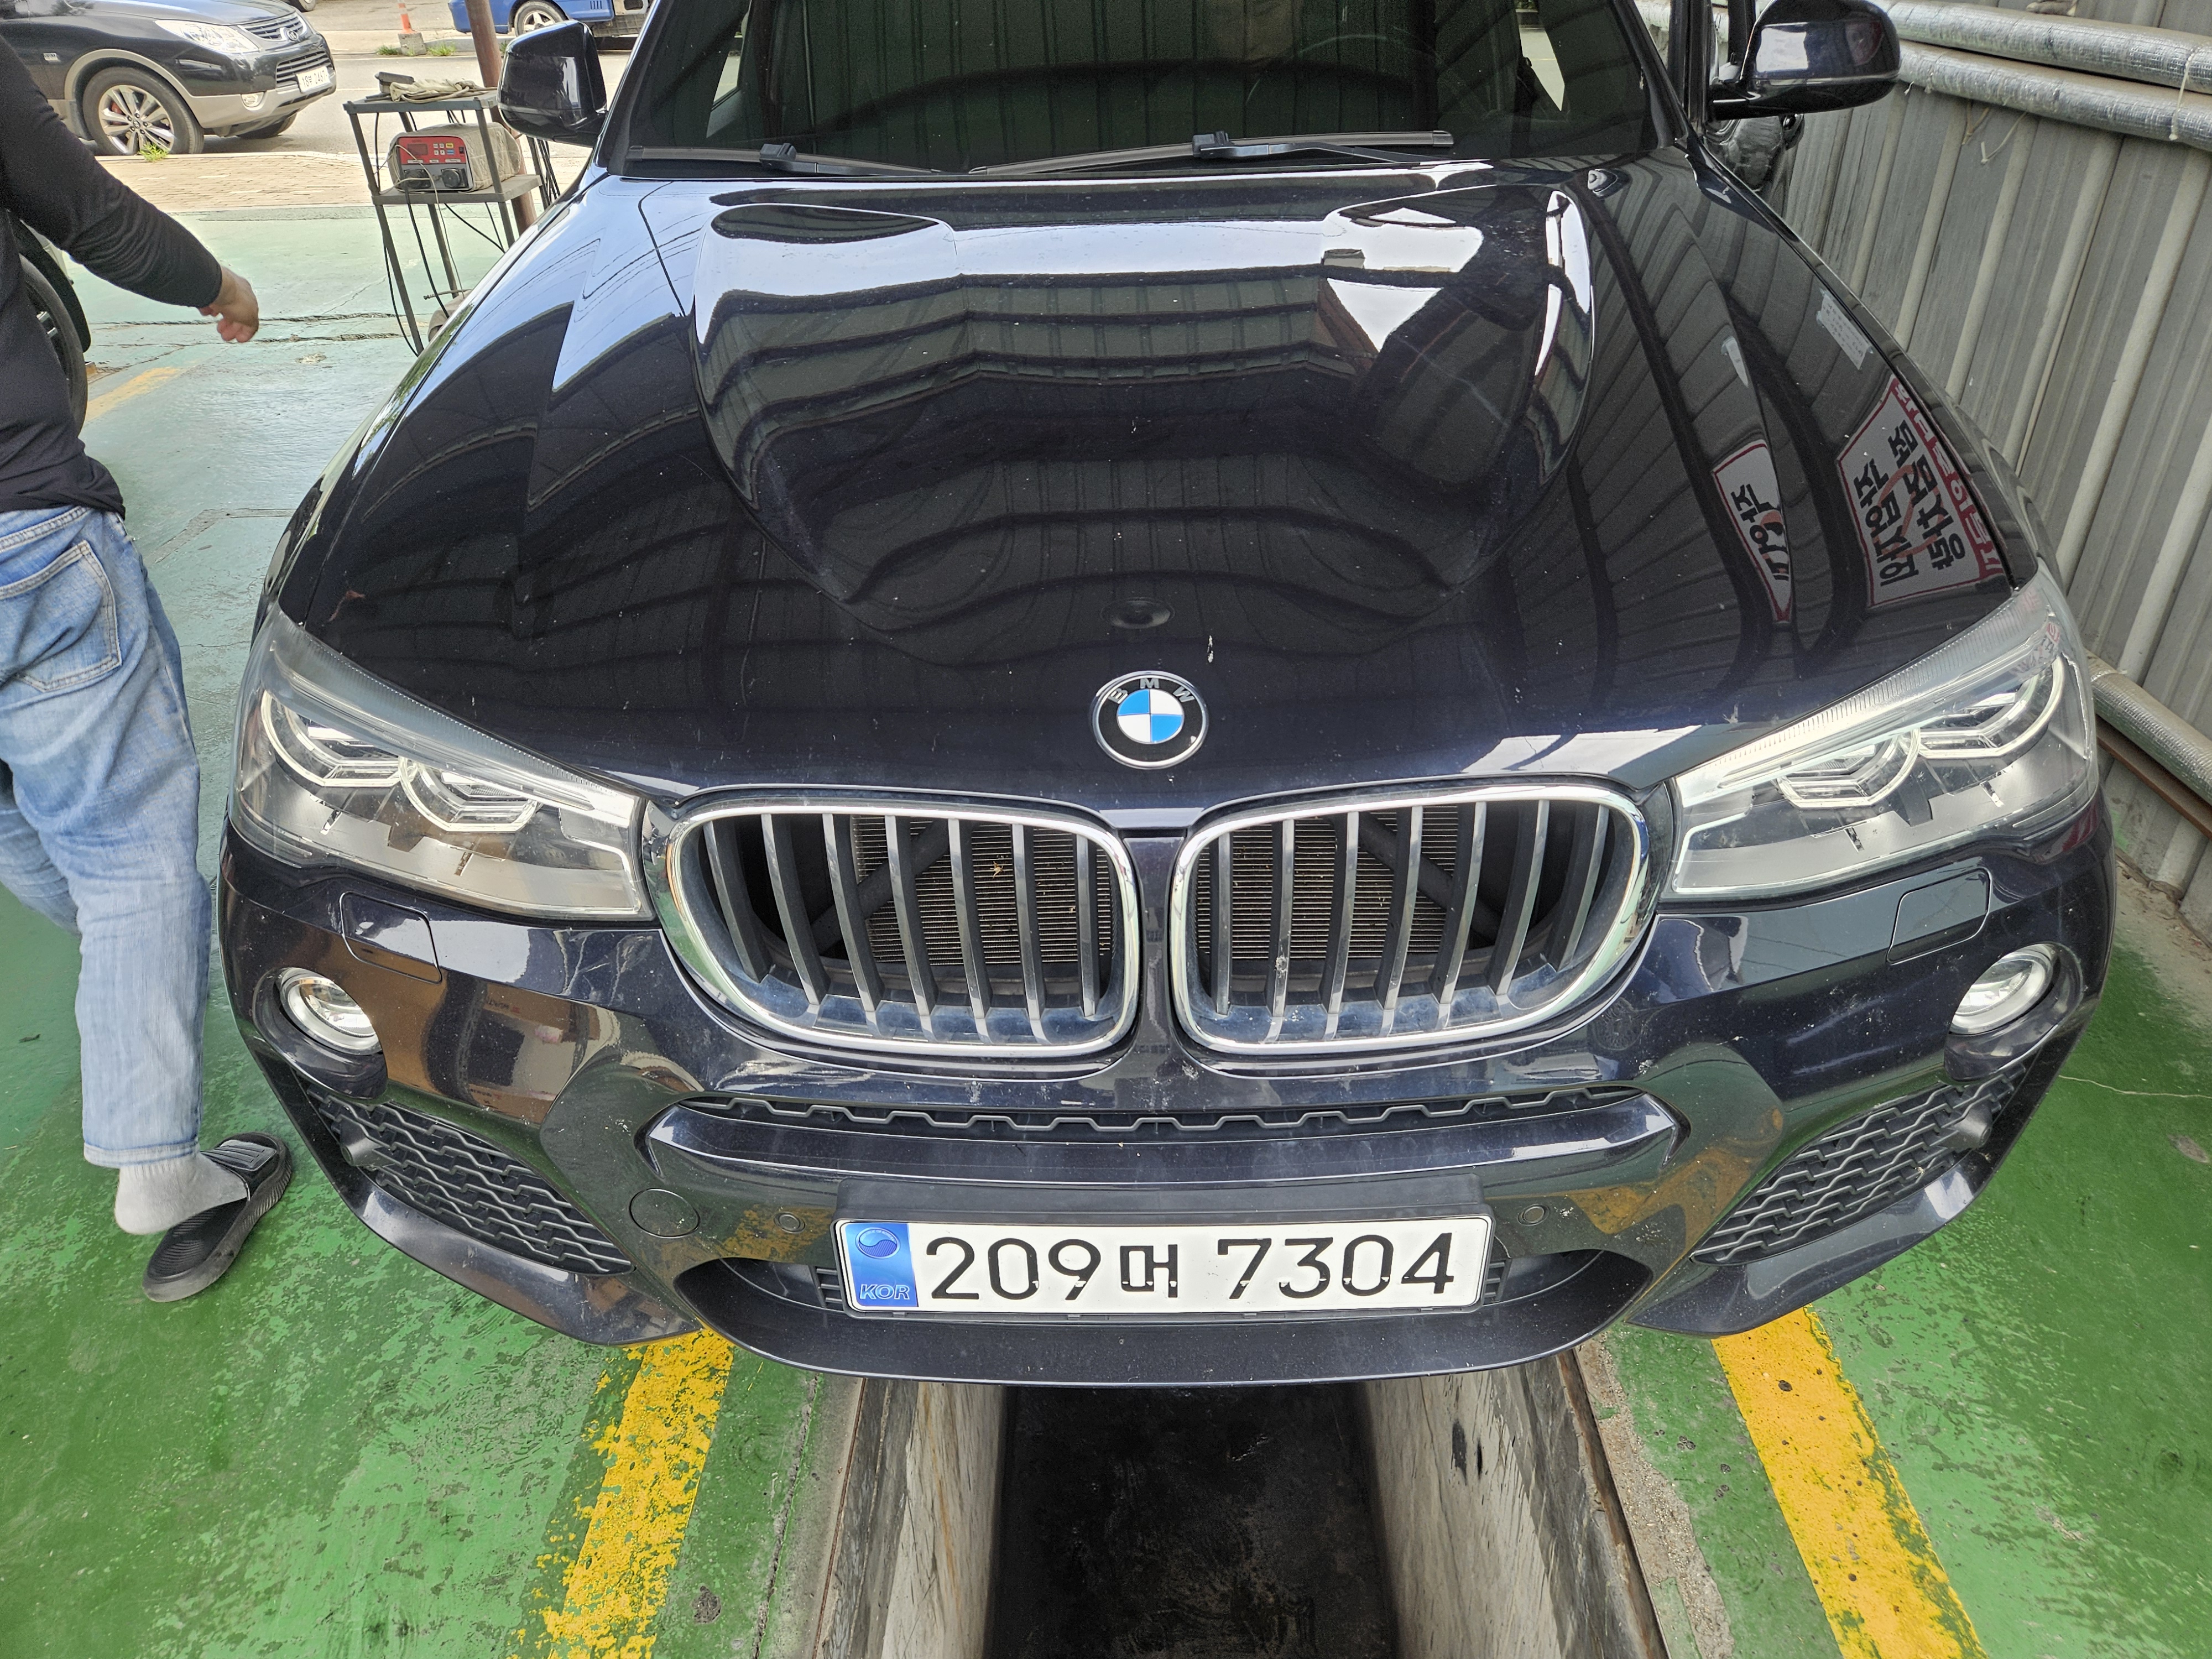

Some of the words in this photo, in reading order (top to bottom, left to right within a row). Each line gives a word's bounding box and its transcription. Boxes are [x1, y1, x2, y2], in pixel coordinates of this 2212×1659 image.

[1108, 677, 1195, 705] BMW
[926, 1237, 1178, 1300] 209머
[1217, 1232, 1454, 1300] 7304
[859, 1284, 910, 1300] KOR
